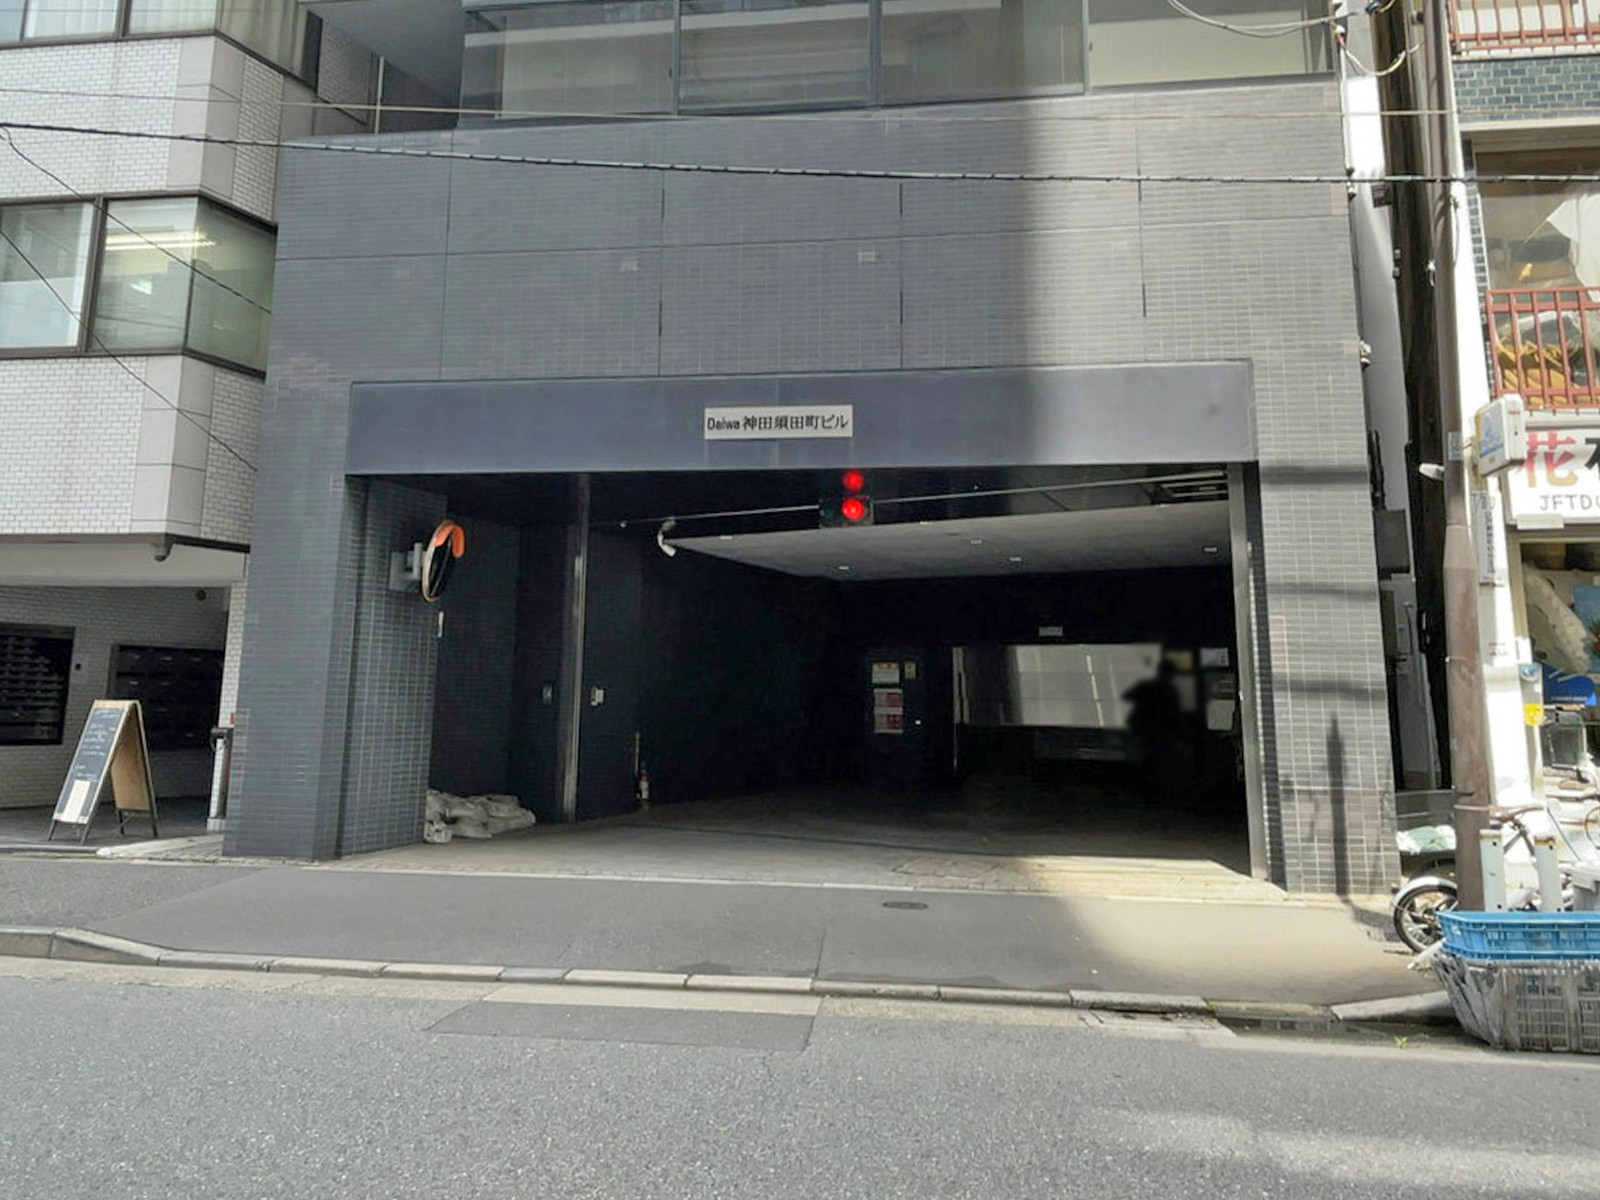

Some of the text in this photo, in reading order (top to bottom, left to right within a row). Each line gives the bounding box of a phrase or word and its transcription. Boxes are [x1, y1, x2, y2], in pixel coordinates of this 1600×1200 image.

[707, 414, 849, 431] Daiwa 神田須田町ビル
